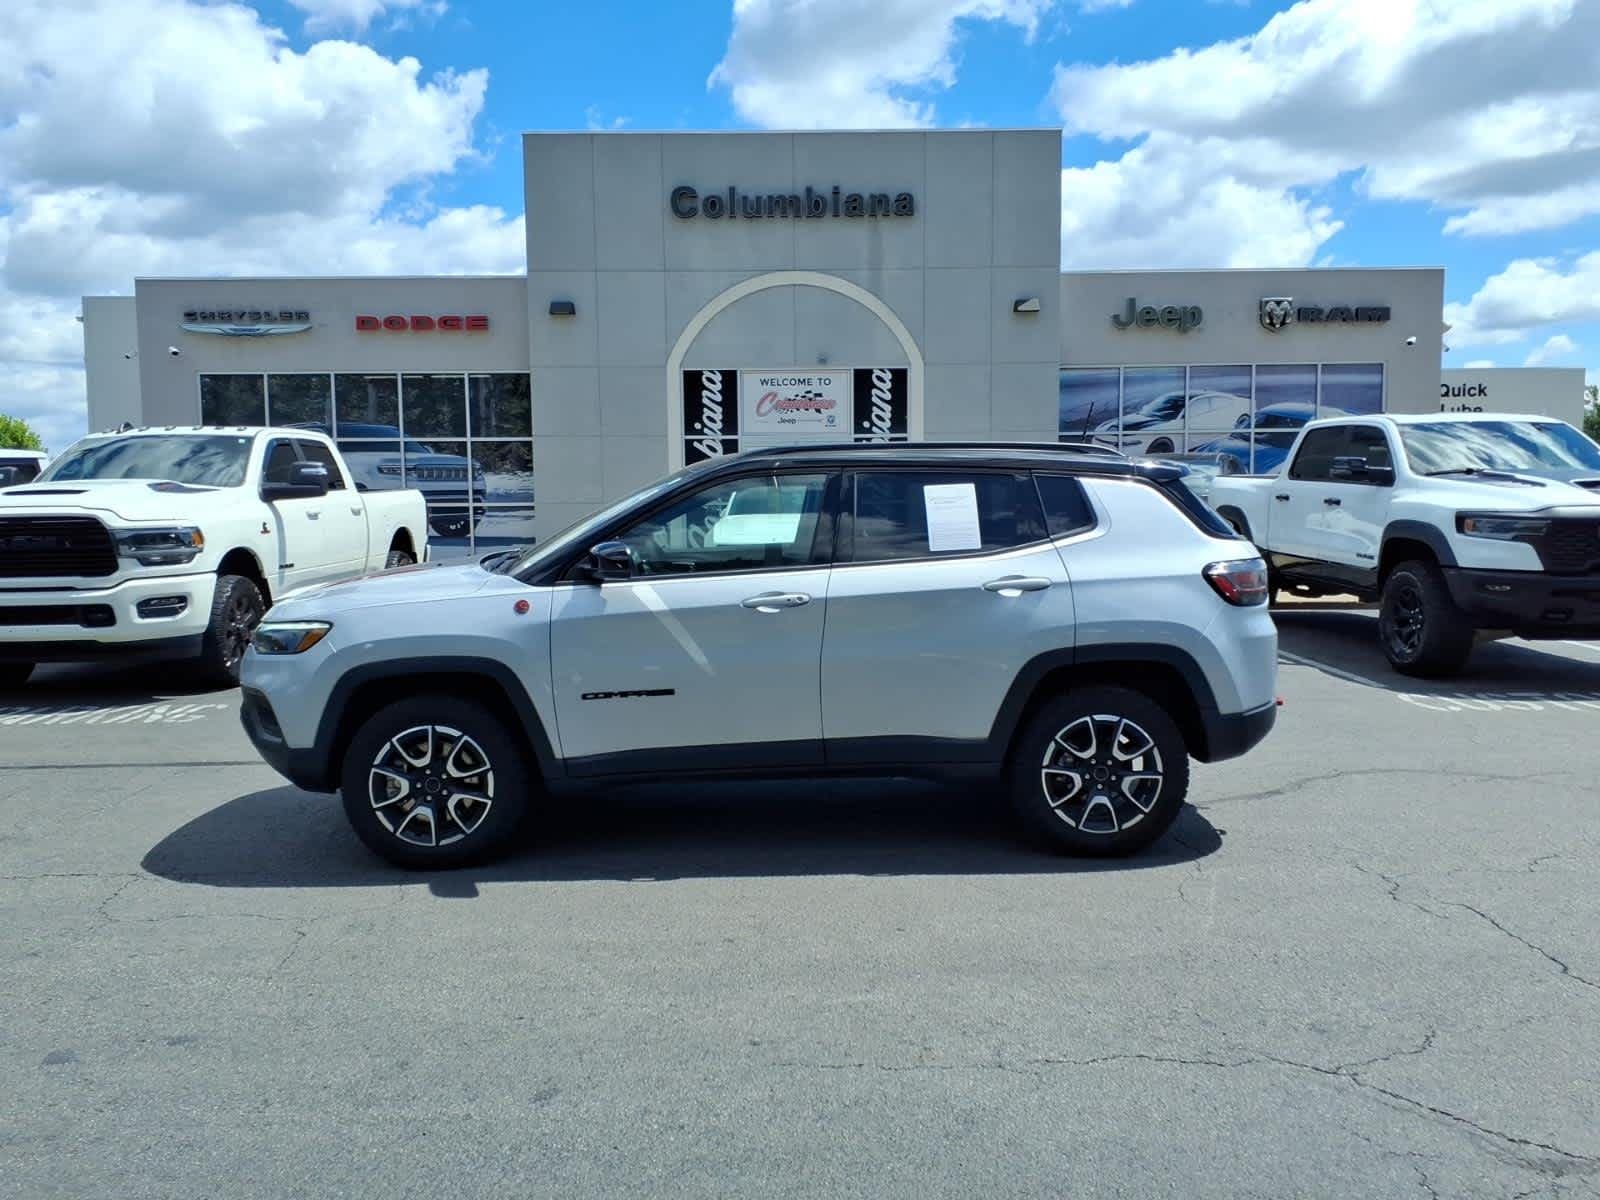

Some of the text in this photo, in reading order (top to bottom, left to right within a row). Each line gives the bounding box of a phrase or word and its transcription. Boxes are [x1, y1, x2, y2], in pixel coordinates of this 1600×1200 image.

[671, 185, 914, 218] Columbiana
[1111, 297, 1202, 333] Jeep
[1297, 306, 1391, 322] RAM
[356, 315, 489, 330] DODGE
[760, 378, 832, 386] WELCOME TO
[1440, 383, 1487, 397] Quick
[862, 368, 892, 442] iana
